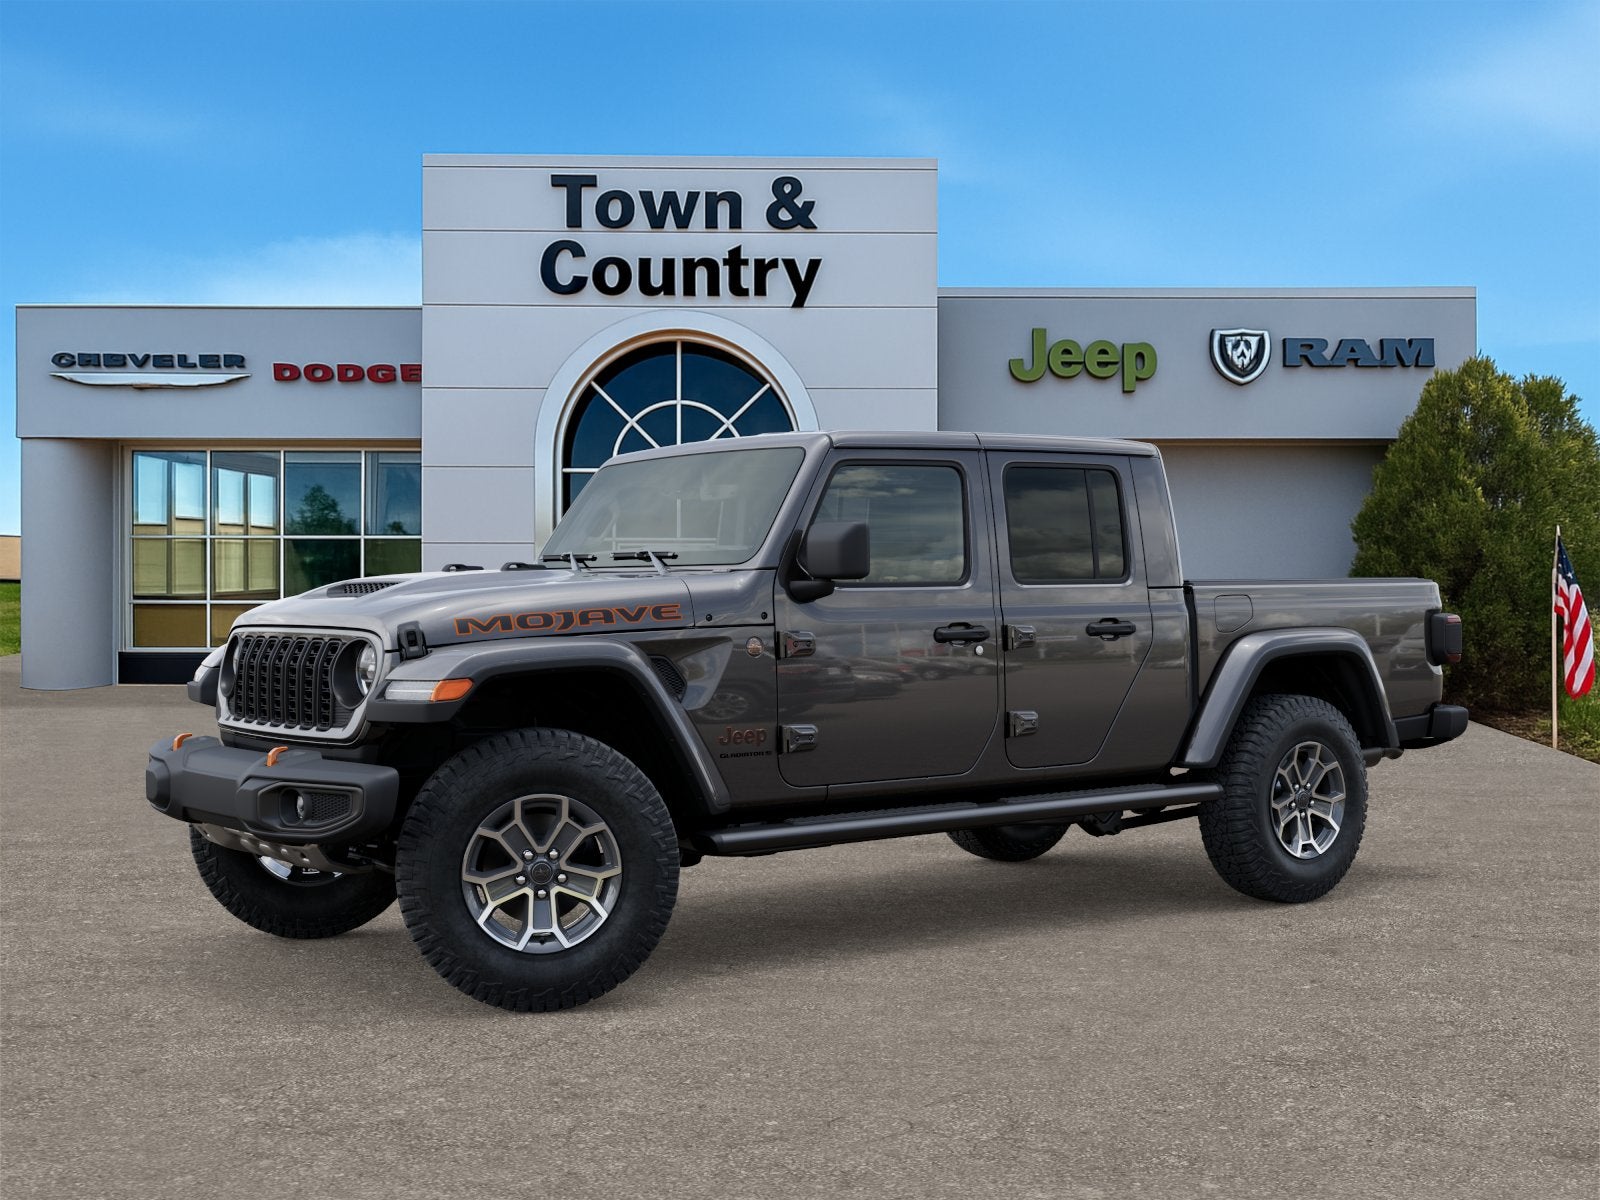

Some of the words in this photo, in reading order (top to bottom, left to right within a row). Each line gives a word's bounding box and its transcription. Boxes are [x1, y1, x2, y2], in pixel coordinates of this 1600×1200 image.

[551, 174, 742, 229] Town
[765, 176, 818, 229] &
[540, 239, 822, 308] Country
[1009, 328, 1158, 393] Jeep
[1282, 337, 1436, 368] RAM
[273, 363, 422, 383] DODGE
[454, 603, 682, 636] MOJAVE
[717, 726, 768, 746] Jeep
